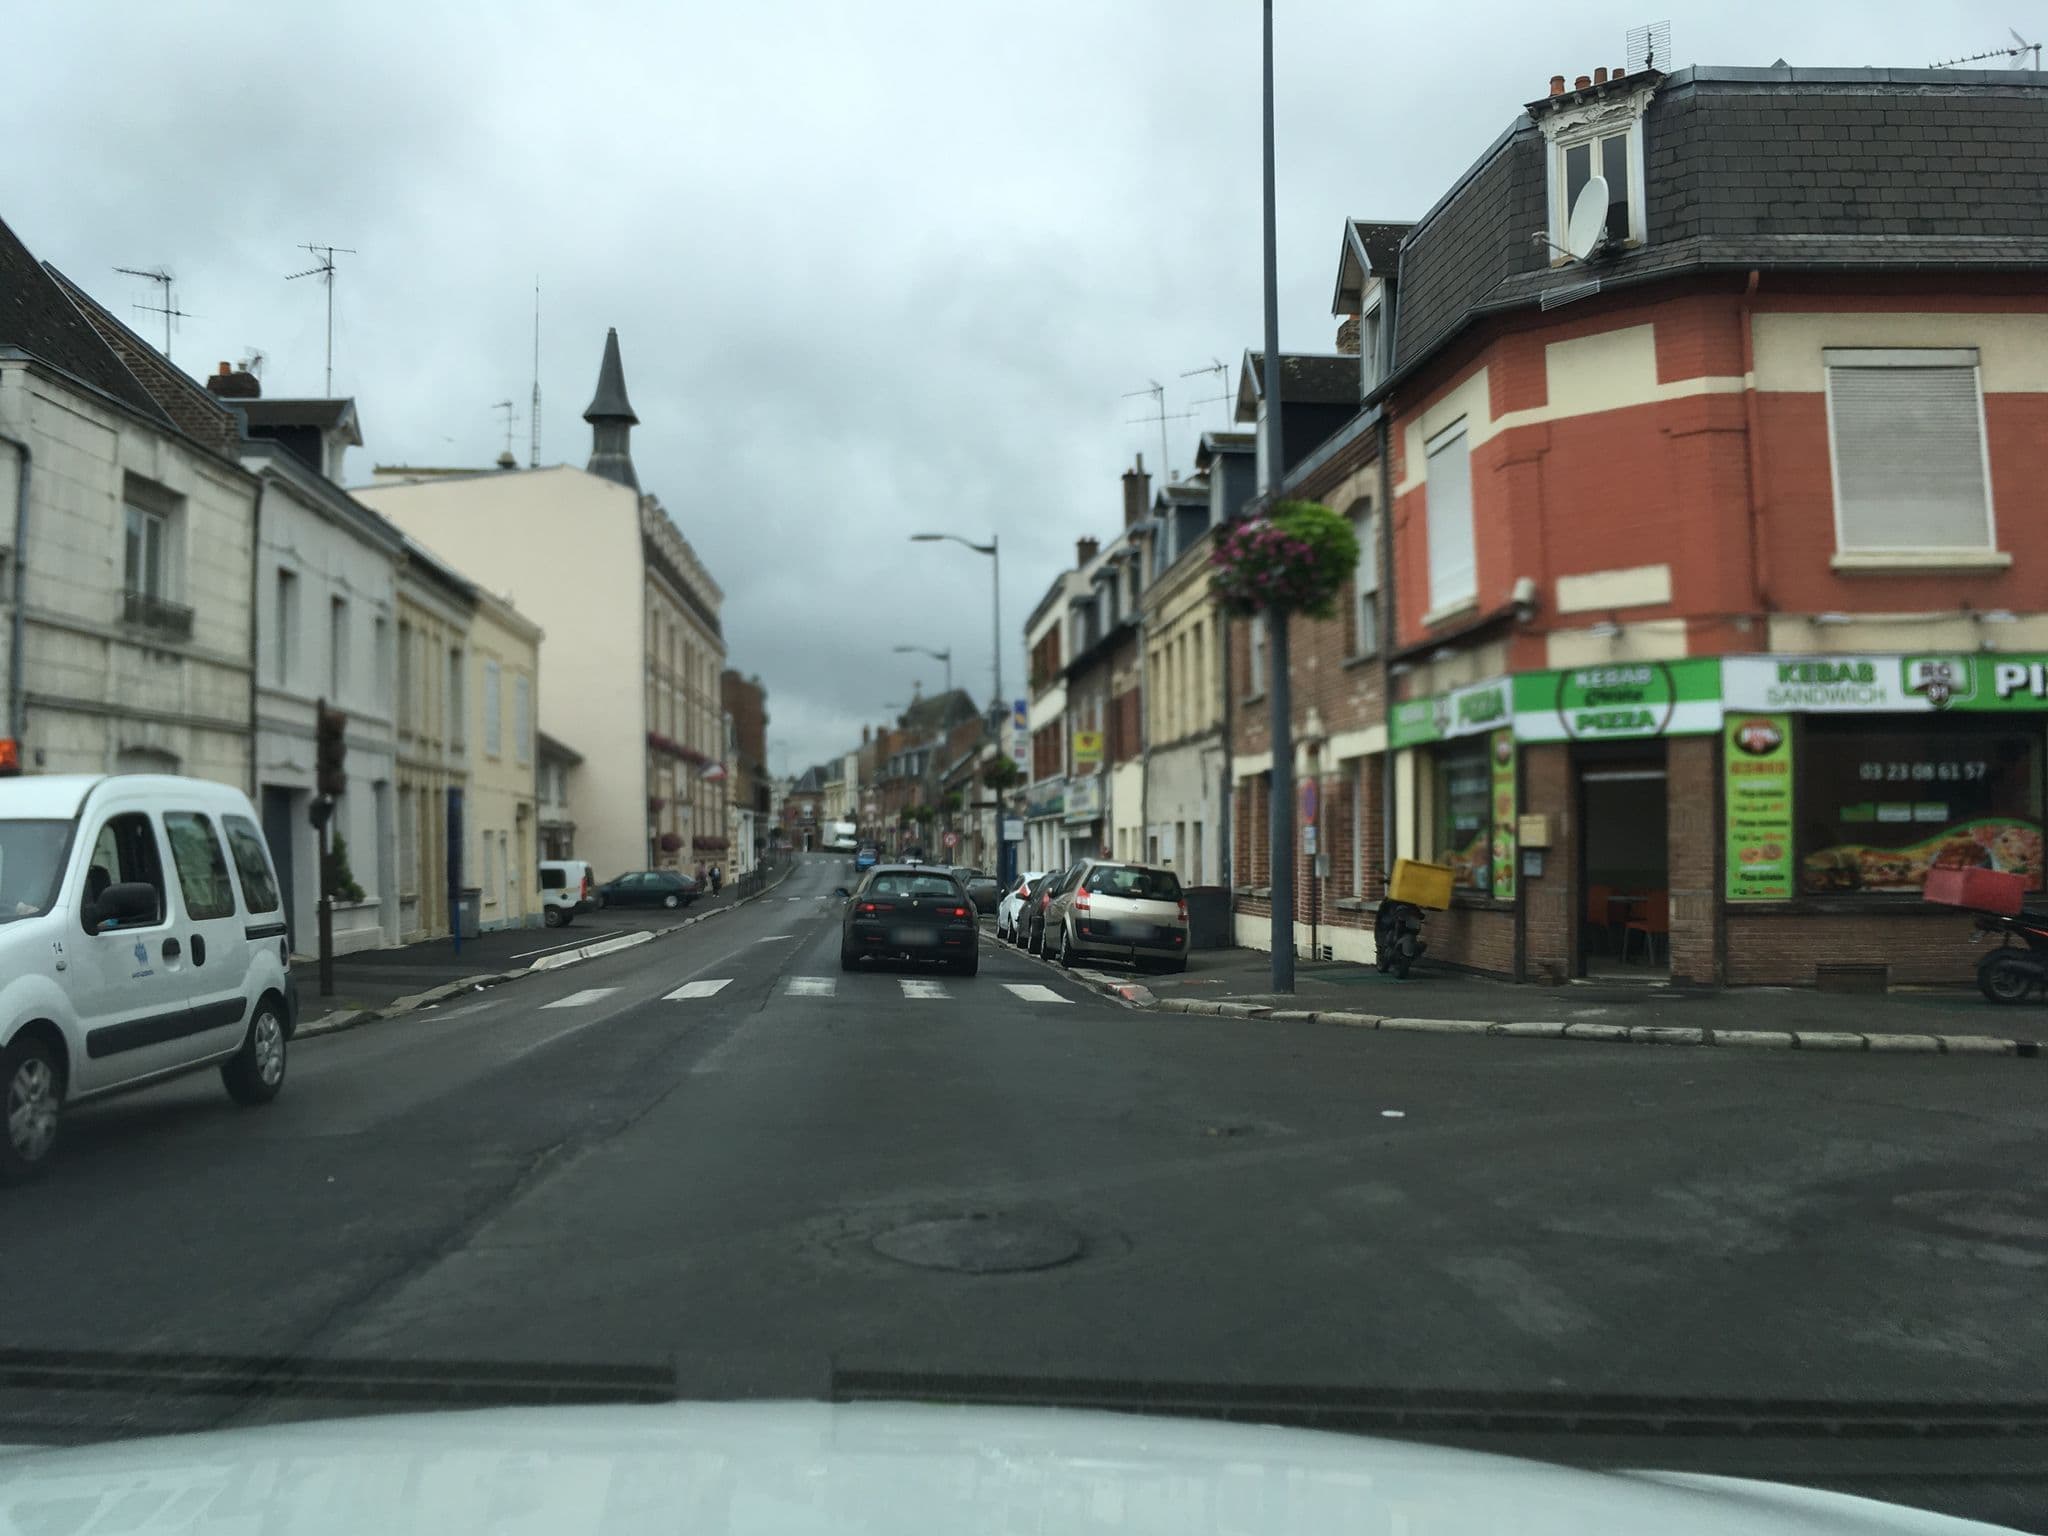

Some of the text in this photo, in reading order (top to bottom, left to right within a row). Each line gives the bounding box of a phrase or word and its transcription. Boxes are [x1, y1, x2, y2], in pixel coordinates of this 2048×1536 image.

[1575, 666, 1653, 688] KEBAB
[1777, 661, 1875, 683] KEBAB
[1995, 662, 2048, 697] PI
[1766, 686, 1887, 706] SANDWICH
[1576, 709, 1656, 732] PIZZA
[1859, 762, 1882, 781] 03
[1886, 762, 1909, 781] 23
